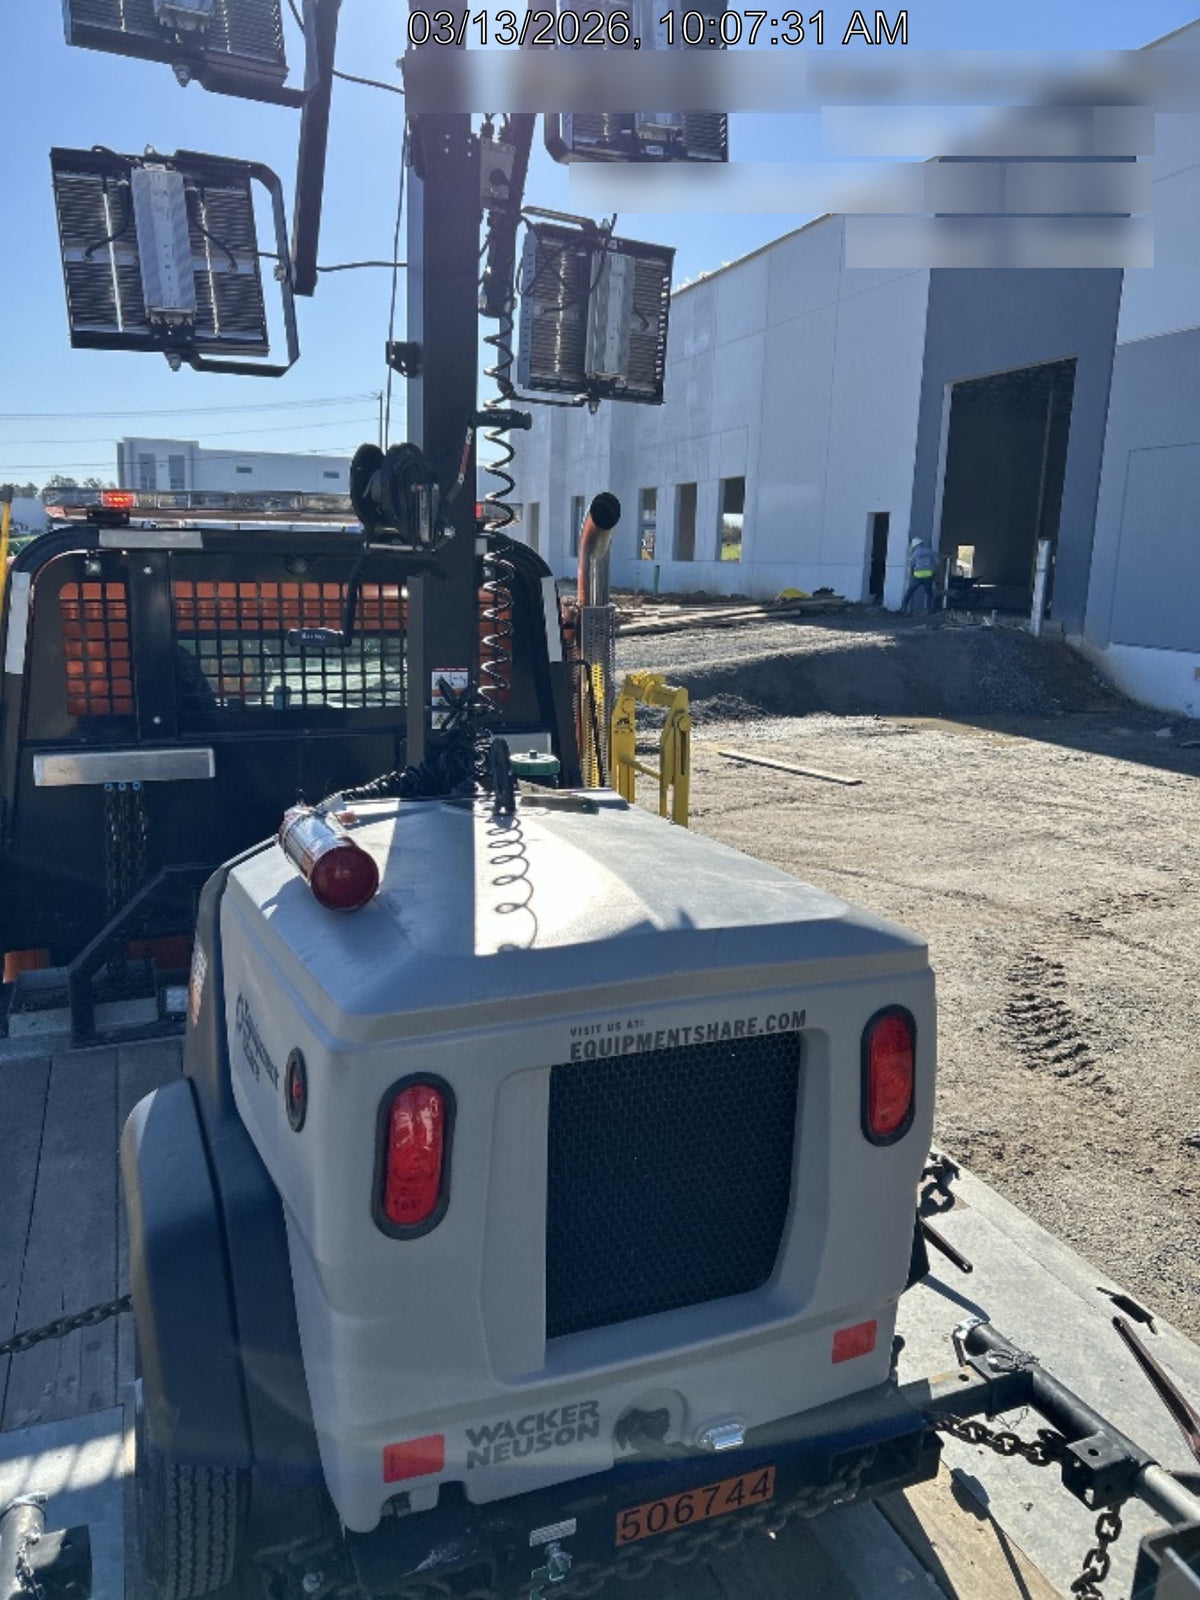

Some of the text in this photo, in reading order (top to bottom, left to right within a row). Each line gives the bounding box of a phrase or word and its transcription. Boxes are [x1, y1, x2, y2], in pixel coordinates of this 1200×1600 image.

[570, 1019, 644, 1038] VISIT US AT:
[570, 1009, 807, 1062] EQUIPMENTSHARE.COM
[465, 1400, 600, 1447] WACKER
[467, 1419, 600, 1470] NEUSON
[620, 1470, 771, 1541] 506744
